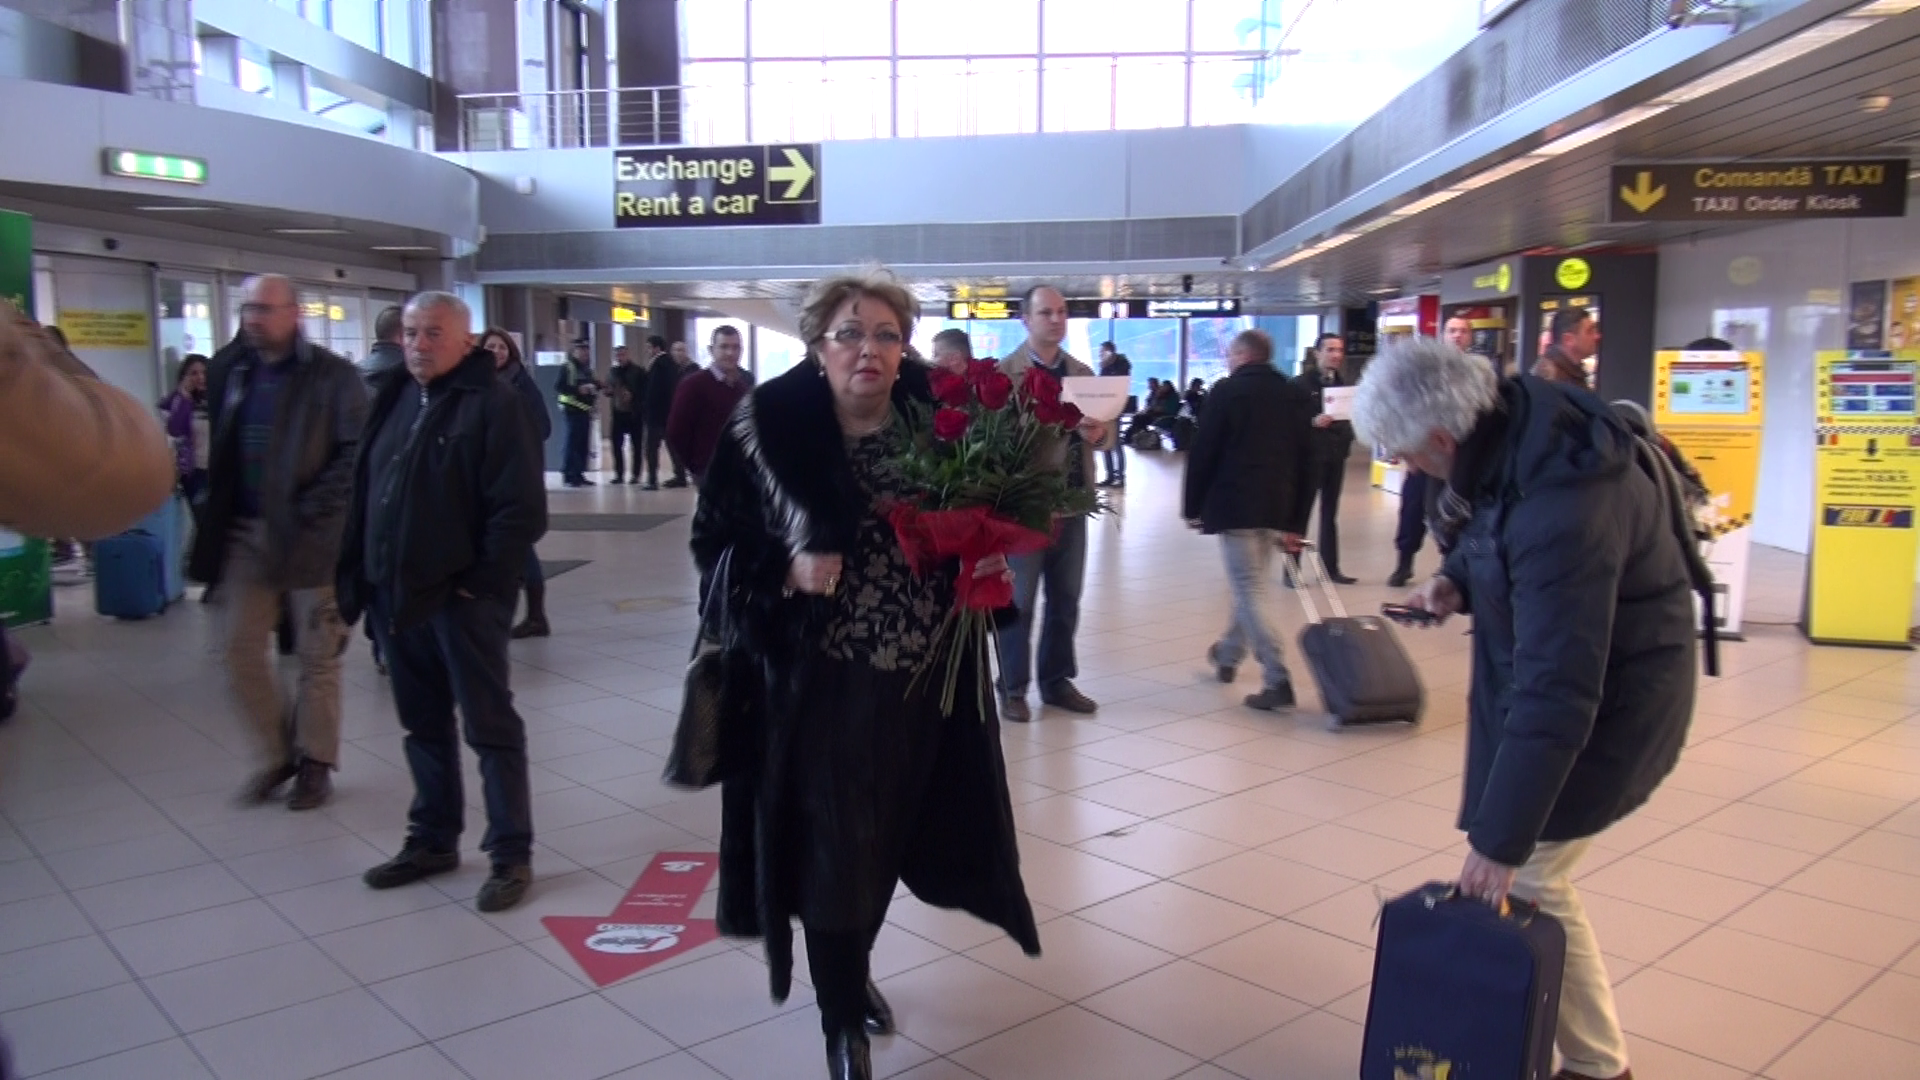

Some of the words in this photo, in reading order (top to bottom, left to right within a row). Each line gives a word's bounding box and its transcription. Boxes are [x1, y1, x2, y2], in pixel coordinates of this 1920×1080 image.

[616, 154, 754, 184] Exchange
[1824, 165, 1884, 185] TAXI
[616, 192, 681, 216] Rent
[688, 196, 705, 215] a
[712, 195, 758, 214] car
[1692, 197, 1739, 212] TAXI
[1745, 196, 1800, 211] Order
[1807, 194, 1861, 211] Kiosk
